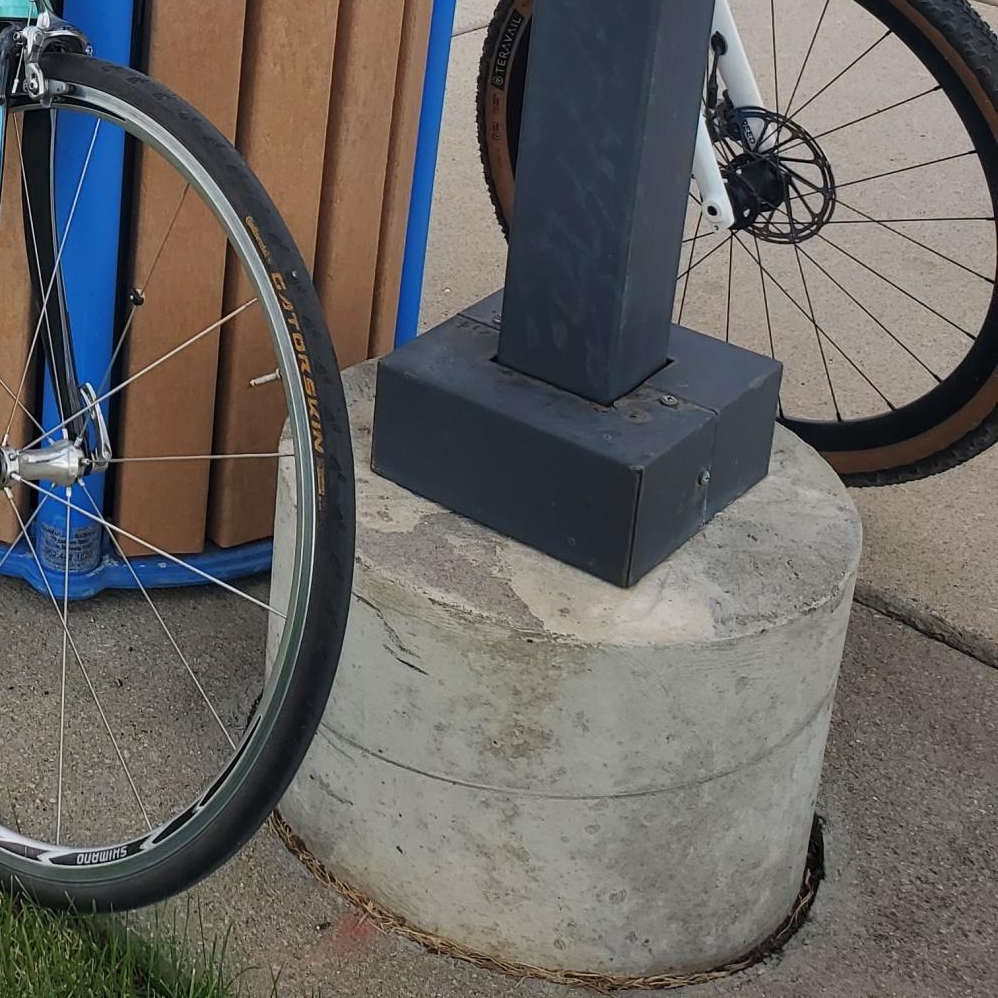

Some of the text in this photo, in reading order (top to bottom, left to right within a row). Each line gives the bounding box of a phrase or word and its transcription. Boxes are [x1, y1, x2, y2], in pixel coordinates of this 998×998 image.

[495, 15, 523, 75] TERAVAIL
[271, 272, 325, 454] GATORSKIN
[76, 845, 128, 865] SHIMANO
